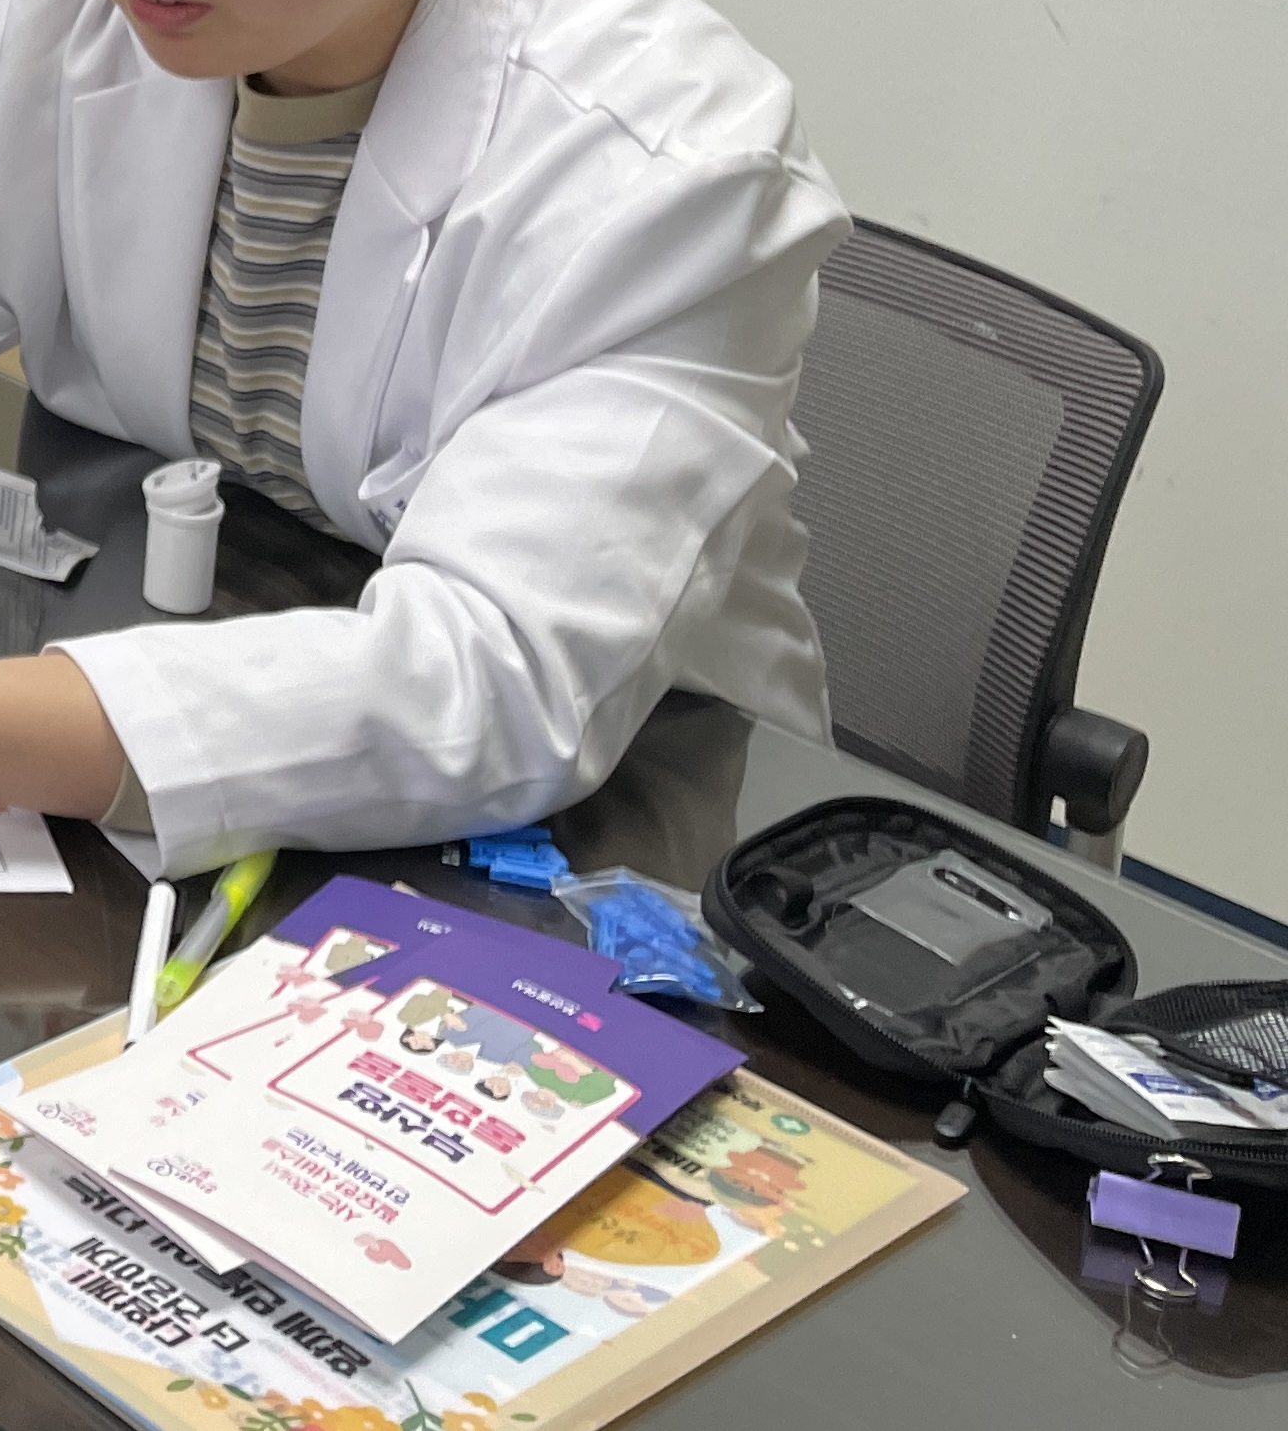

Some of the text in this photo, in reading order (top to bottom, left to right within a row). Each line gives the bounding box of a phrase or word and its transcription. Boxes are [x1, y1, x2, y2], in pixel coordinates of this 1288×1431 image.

[336, 1080, 475, 1164] 부산형
[70, 1236, 251, 1354] 더 건강하게
[272, 1310, 373, 1379] 함께
